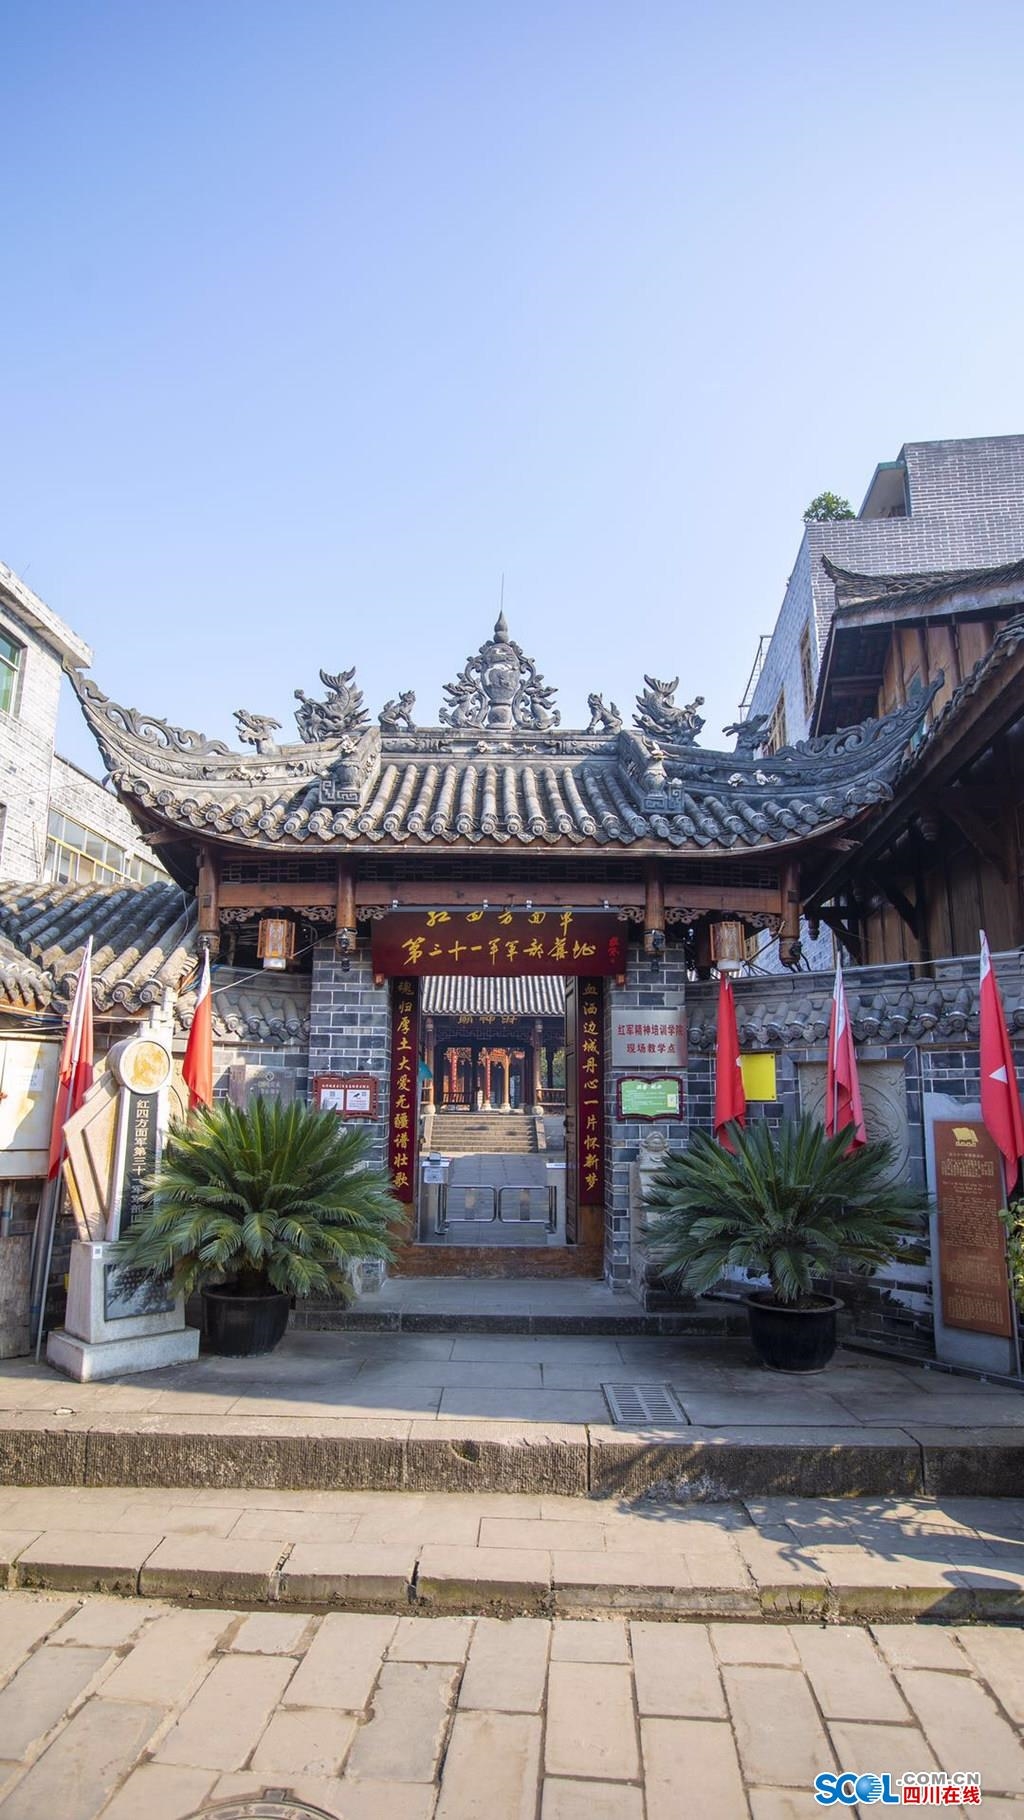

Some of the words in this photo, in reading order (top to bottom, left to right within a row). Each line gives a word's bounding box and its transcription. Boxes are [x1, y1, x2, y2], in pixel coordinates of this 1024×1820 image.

[626, 1043, 677, 1055] 现场教学点
